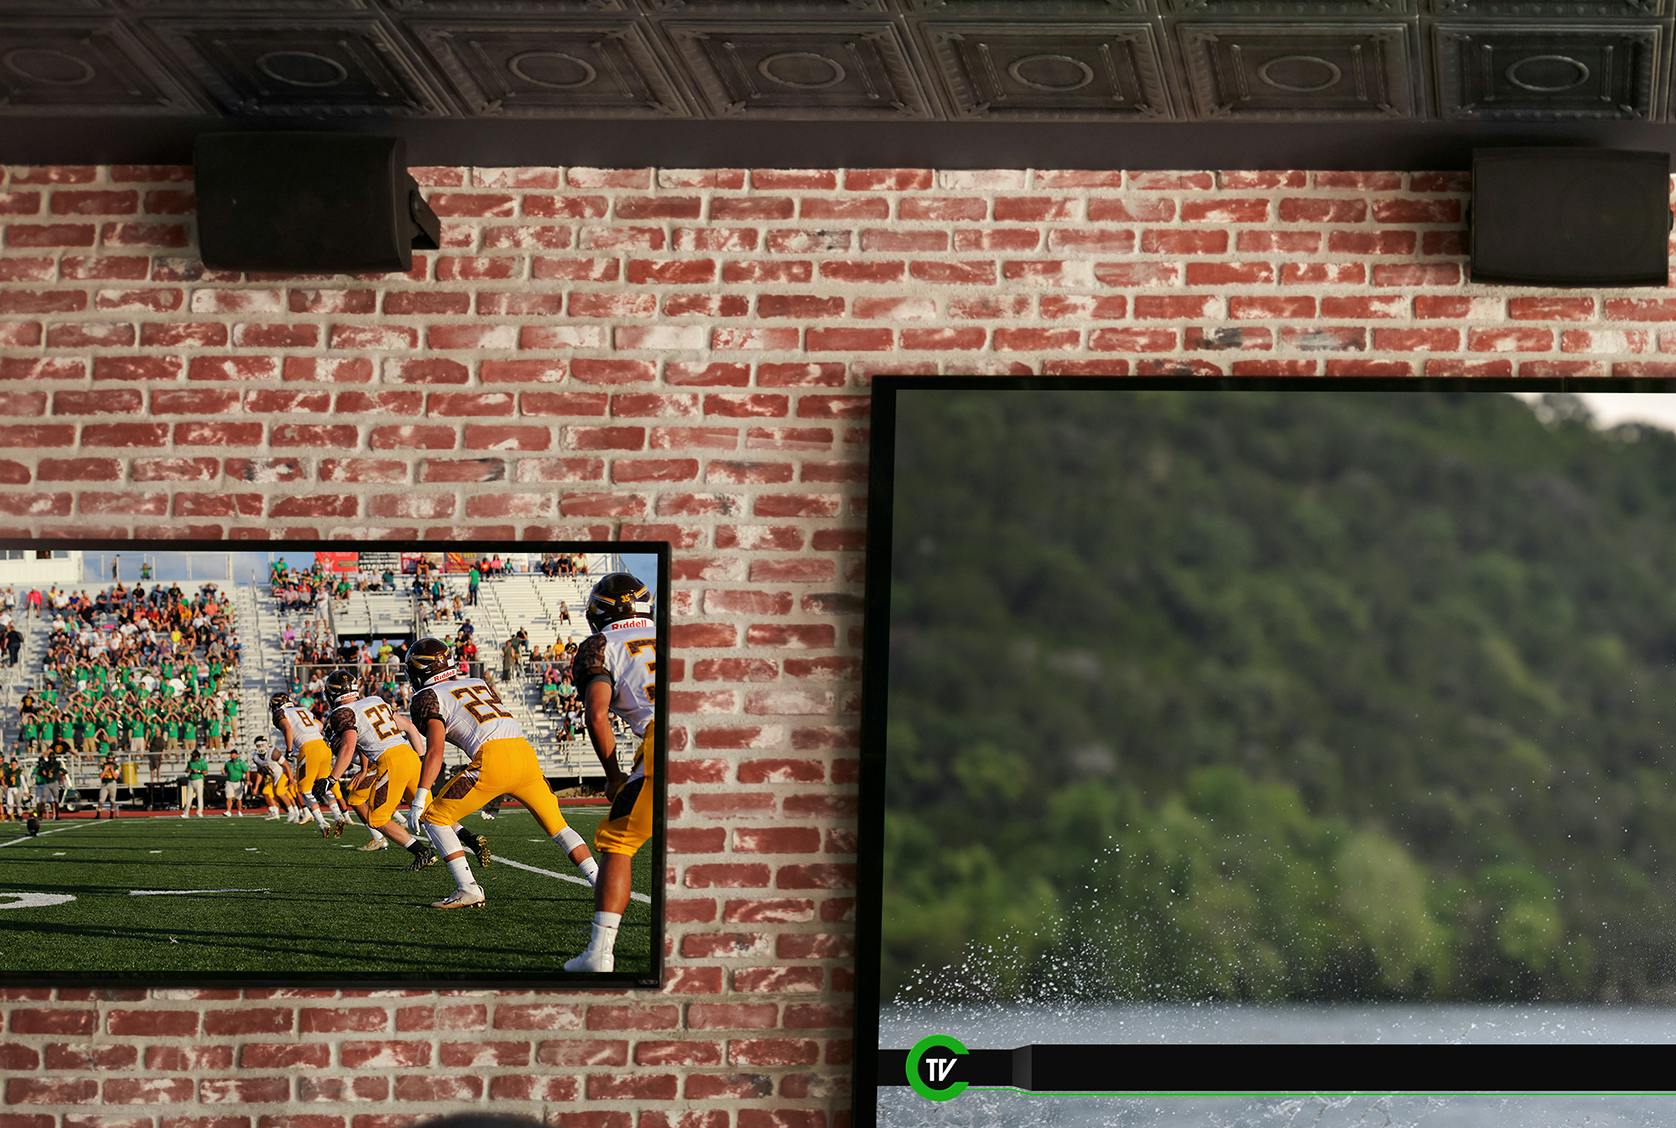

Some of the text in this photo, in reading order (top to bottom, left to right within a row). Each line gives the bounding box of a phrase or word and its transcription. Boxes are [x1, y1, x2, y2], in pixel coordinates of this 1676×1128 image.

[621, 594, 631, 603] 35
[611, 619, 647, 631] Riddell
[450, 685, 514, 725] 22
[296, 710, 314, 727] 8
[926, 1058, 958, 1082] TV
